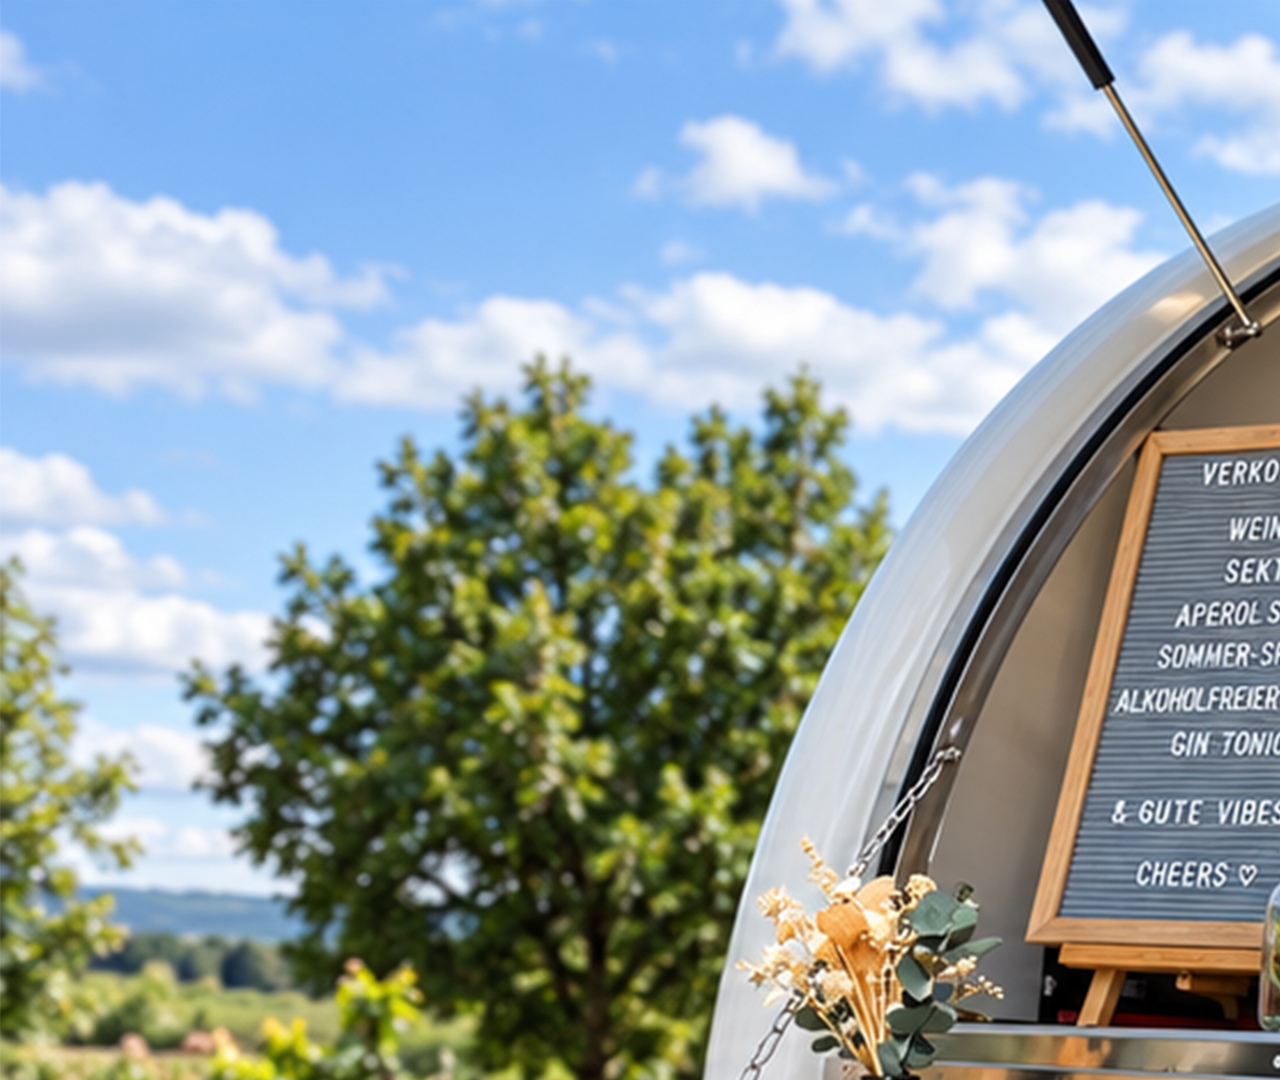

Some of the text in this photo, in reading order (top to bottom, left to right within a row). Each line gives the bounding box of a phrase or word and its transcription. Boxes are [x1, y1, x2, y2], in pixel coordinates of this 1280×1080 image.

[1174, 600, 1262, 628] APEROL
[1114, 685, 1280, 714] ALKOHOLFREIER
[1170, 732, 1210, 757] GIN
[1111, 801, 1128, 825] &
[1138, 800, 1203, 825] GUTE
[1135, 861, 1229, 888] CHEERS
